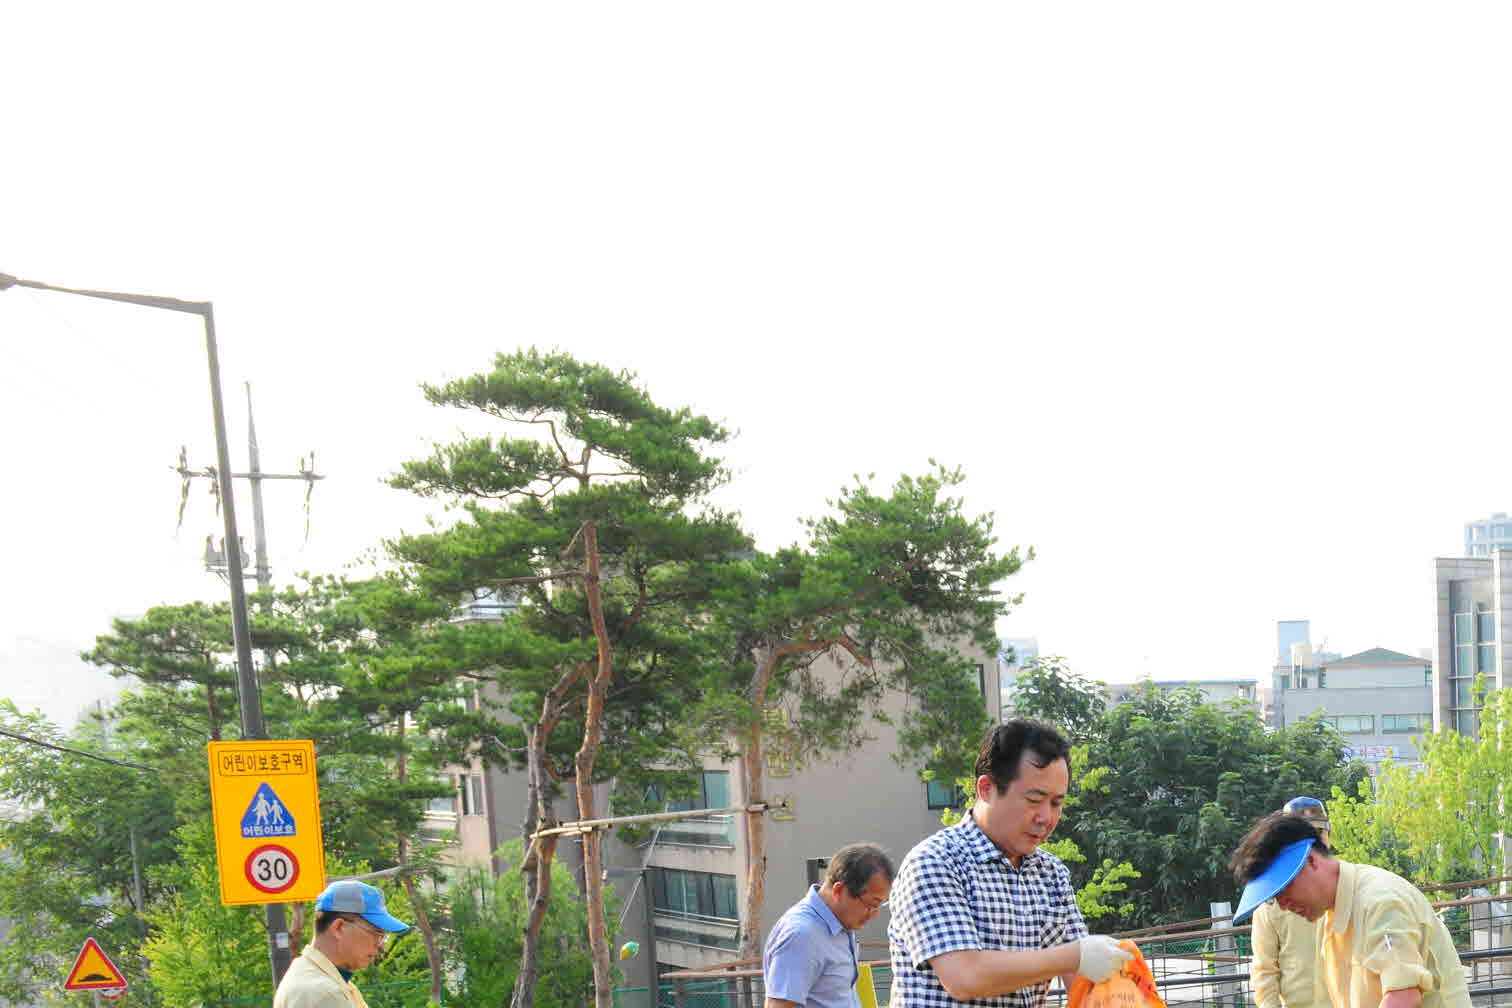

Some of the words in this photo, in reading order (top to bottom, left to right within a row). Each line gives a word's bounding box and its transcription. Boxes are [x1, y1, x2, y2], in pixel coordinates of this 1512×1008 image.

[223, 752, 304, 772] 어린이보호구역
[242, 824, 295, 836] 어린이보호
[257, 858, 288, 881] 30
